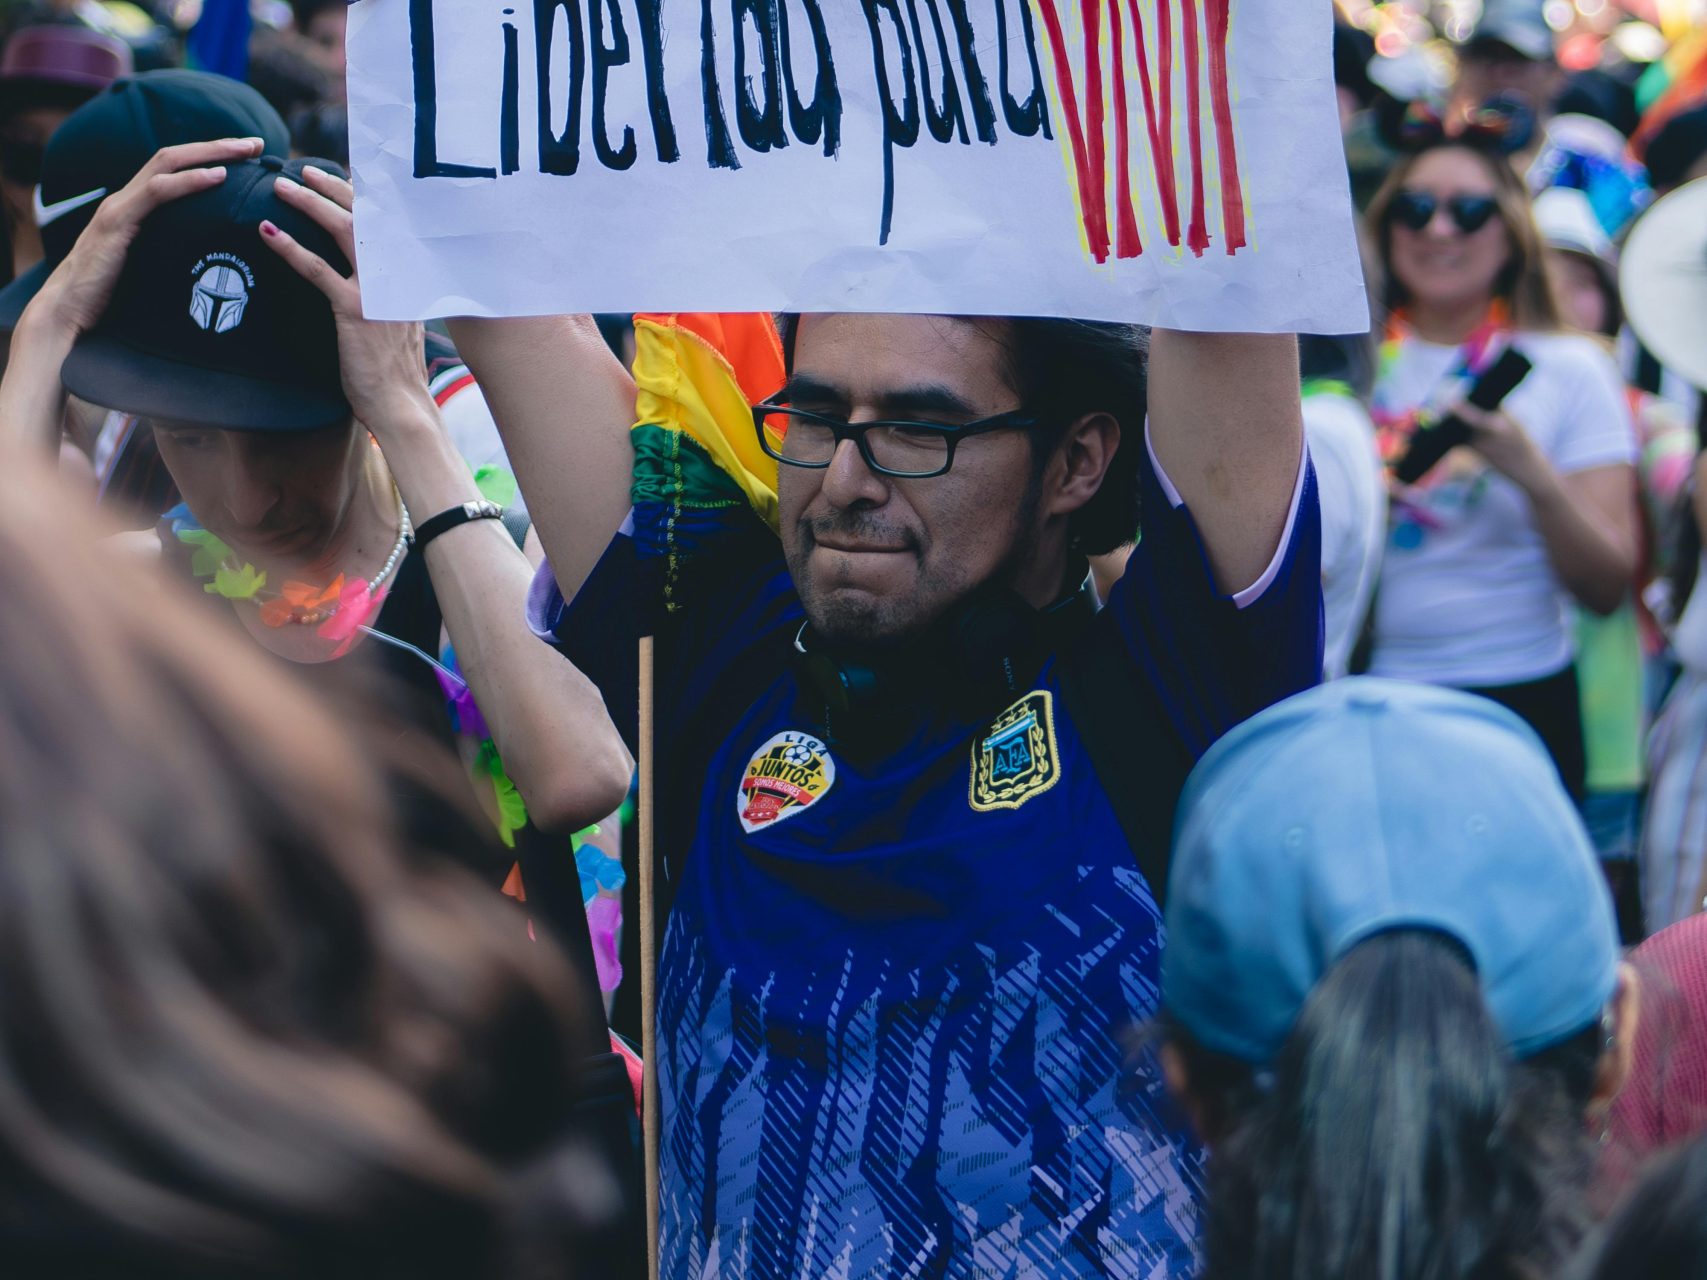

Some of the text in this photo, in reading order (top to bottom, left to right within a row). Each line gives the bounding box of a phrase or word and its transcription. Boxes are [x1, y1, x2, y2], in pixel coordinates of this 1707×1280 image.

[206, 252, 255, 288] MANDALORIAN
[784, 734, 828, 757] LIGA
[991, 737, 1031, 775] AFA
[757, 759, 815, 787] JUNTOS
[753, 778, 801, 797] SOMOS MEJORES
